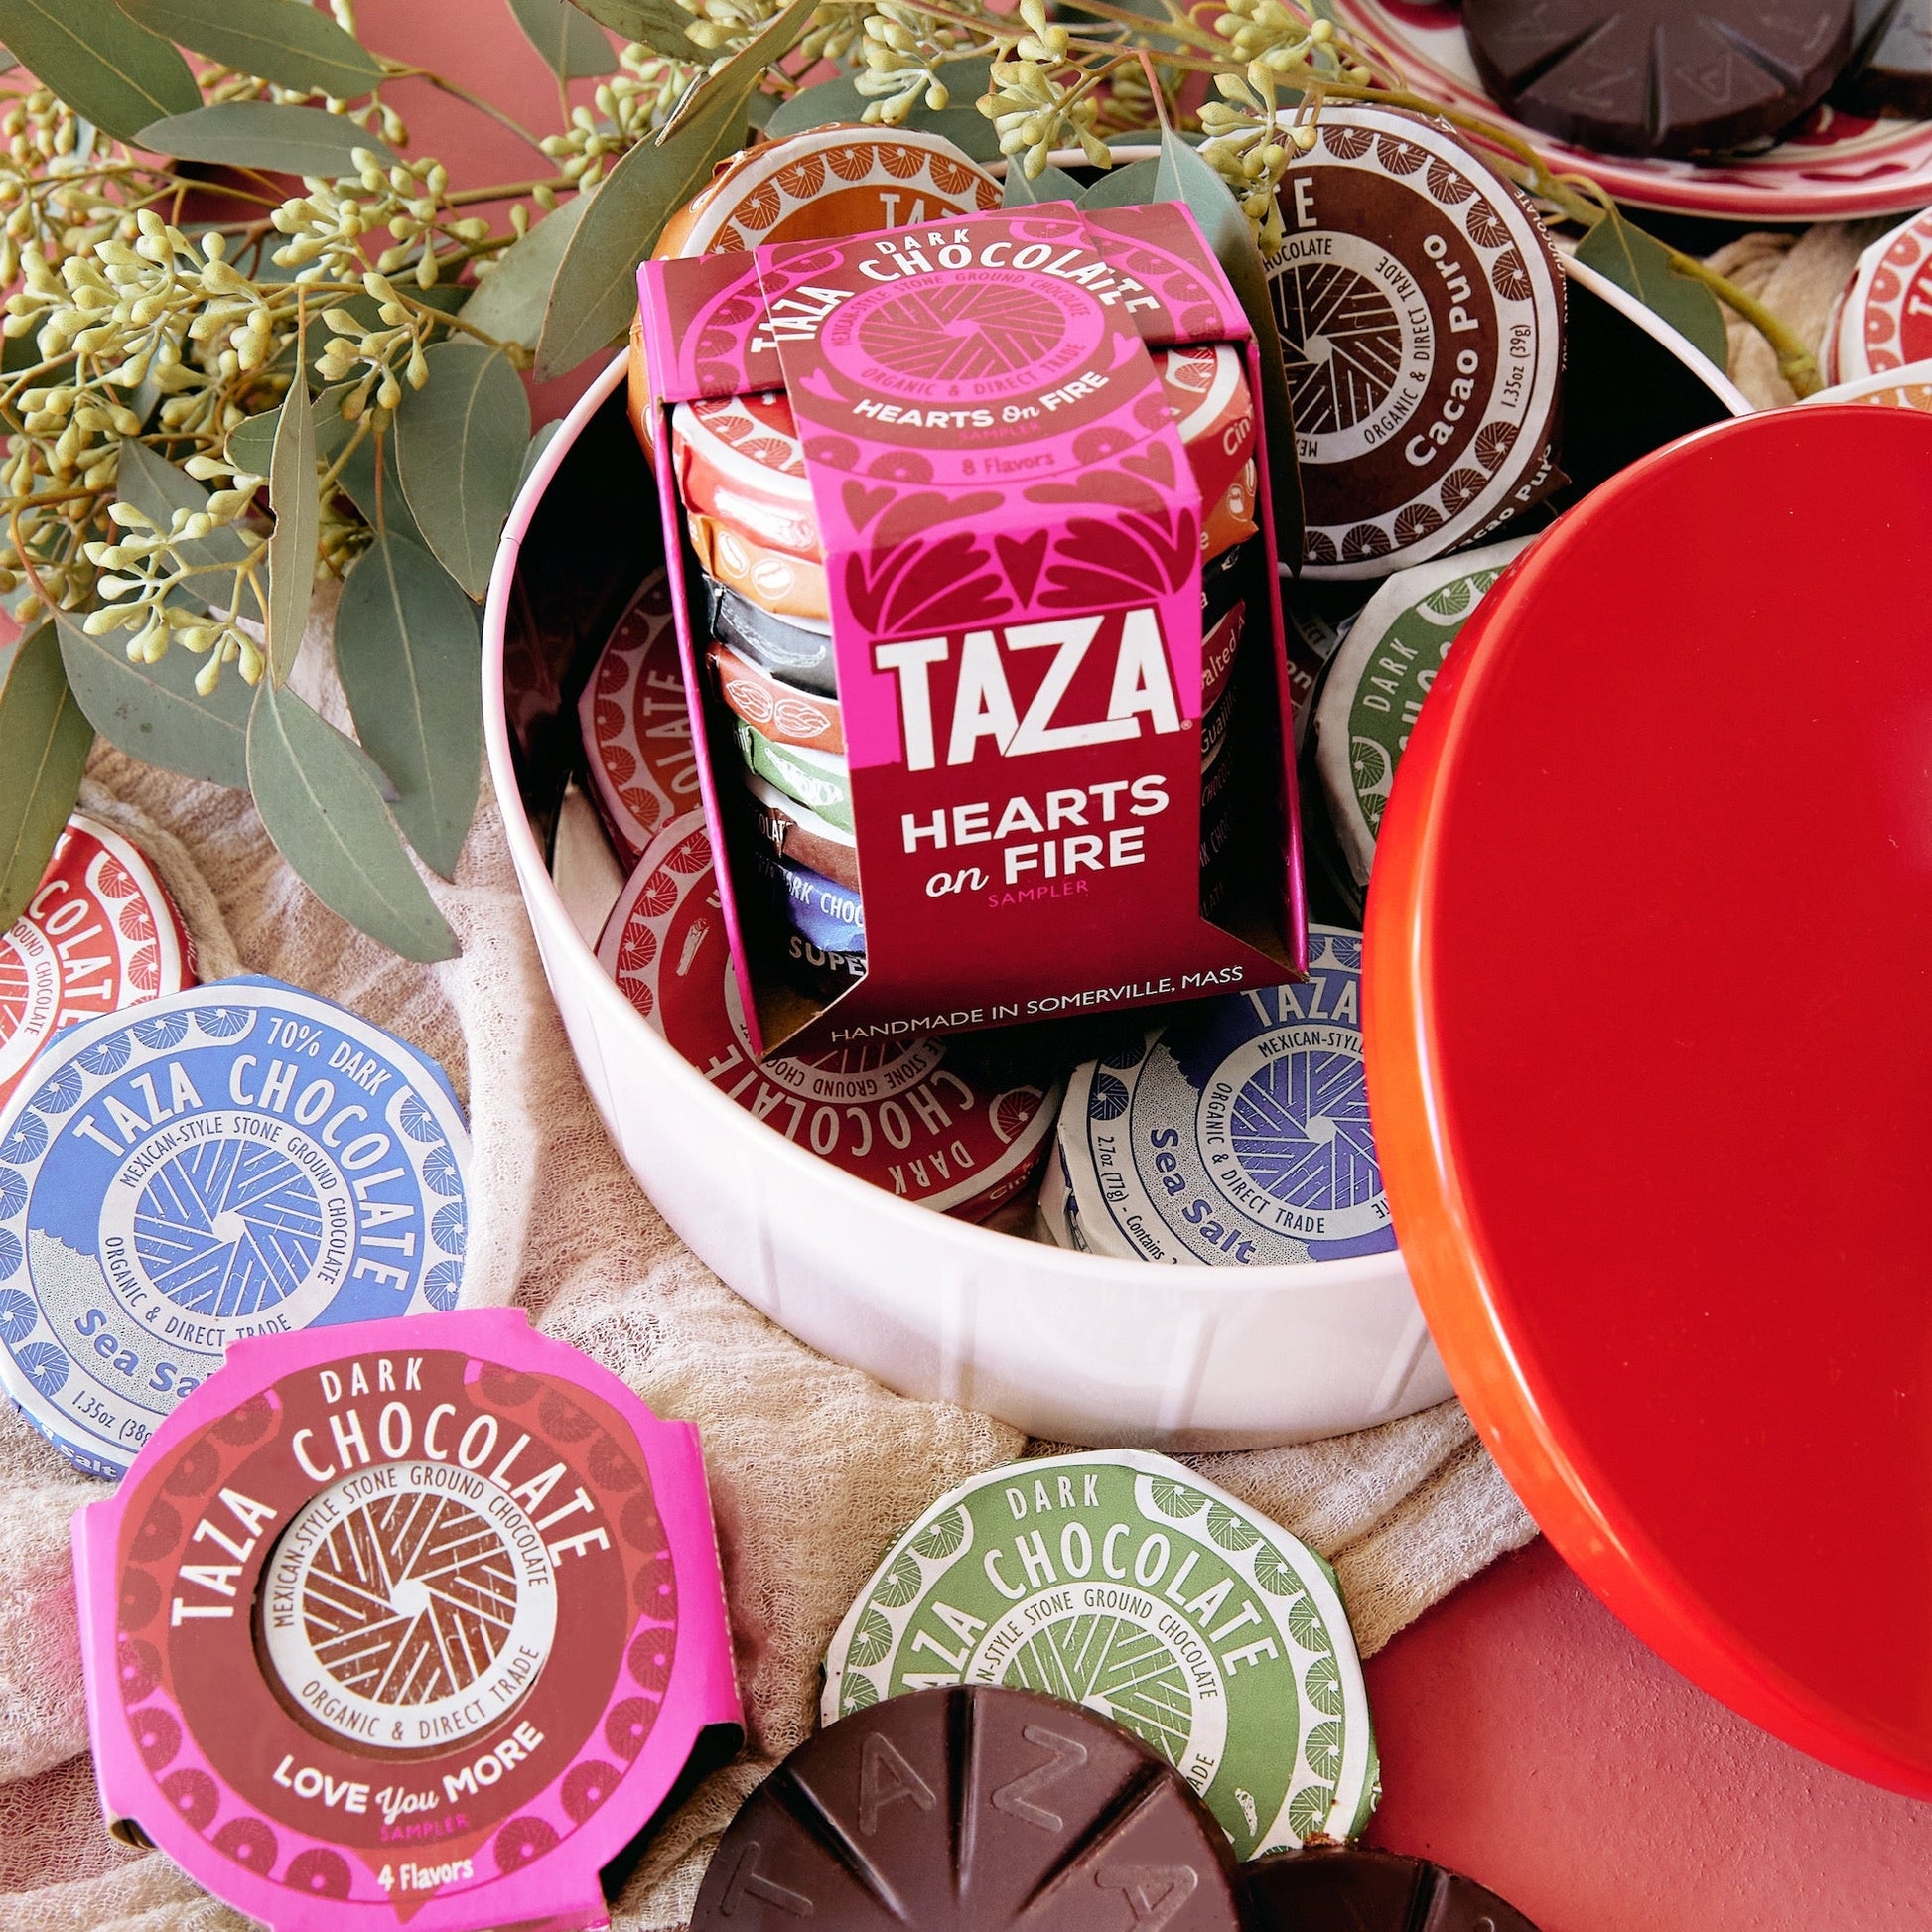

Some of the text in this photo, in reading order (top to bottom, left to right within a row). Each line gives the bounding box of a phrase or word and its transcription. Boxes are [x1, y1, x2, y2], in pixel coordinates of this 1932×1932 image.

[875, 228, 971, 255] DARK
[751, 241, 1161, 353] TAZA CHOCOLATE
[831, 272, 1091, 347] MEXICAN-STYLE STONE GROUND CHOCOLATE
[860, 342, 1086, 397] ORGANIC & DIRECT TRADE
[1364, 255, 1431, 445] ORGANIC & DIRECT TRADE
[1404, 234, 1479, 467] Cacao Puro
[1501, 324, 1531, 409] 1.35oz (39g)
[852, 398, 995, 429] HEARTS
[1038, 370, 1111, 412] FIRE
[959, 421, 1041, 443] SAMPLER
[961, 452, 1056, 477] 8 Flavors
[875, 608, 1181, 772] TAZA
[1363, 637, 1419, 713] DARK
[900, 774, 1170, 854] HEARTS
[924, 866, 990, 898] on
[1004, 826, 1146, 886] FIRE
[988, 880, 1090, 908] SAMPLER
[24, 961, 52, 1036] CHOCOLATE
[831, 965, 1245, 1043] HANDMADE IN SOMERVILLE, MASS
[1240, 978, 1361, 1028] TAZA
[266, 1017, 392, 1096] 70% DARK
[813, 1079, 878, 1097] GROUND
[885, 1052, 927, 1089] STONE
[72, 1054, 415, 1291] TAZA CHOCOLATE
[1150, 1128, 1255, 1264] Sea Salt
[1206, 1082, 1326, 1234] ORGANIC & DIRECT TRADE
[119, 1116, 347, 1285] MEXICAN-STYLE STONE GROUND CHOCOLATE
[1097, 1136, 1114, 1168] 2.7oz
[1126, 1214, 1165, 1261] Contains
[104, 1236, 147, 1308] ORGANIC
[145, 1306, 162, 1323] &
[164, 1315, 226, 1347] DIRECT
[74, 1308, 208, 1398] Sea Sa
[320, 1357, 424, 1404] DARK
[72, 1390, 116, 1428] 1.35oz
[60, 1444, 117, 1477] Salt
[1005, 1474, 1100, 1520] DARK
[171, 1401, 611, 1626] TAZA CHOCOLATE
[272, 1465, 549, 1629] MEXICAN-STYLE STONE GROUND CHOCOLATE
[984, 1521, 1280, 1677] CHOCOLATE
[1024, 1590, 1074, 1626] STONE
[1084, 1588, 1154, 1619] GROUND
[1158, 1613, 1219, 1701] CHOCOLATE
[302, 1644, 540, 1741] ORGANIC & DIRECT TRADE
[272, 1720, 545, 1825] LOVE You MORE
[380, 1812, 471, 1843] SAMPLER
[377, 1858, 474, 1891] 4 Flavors
